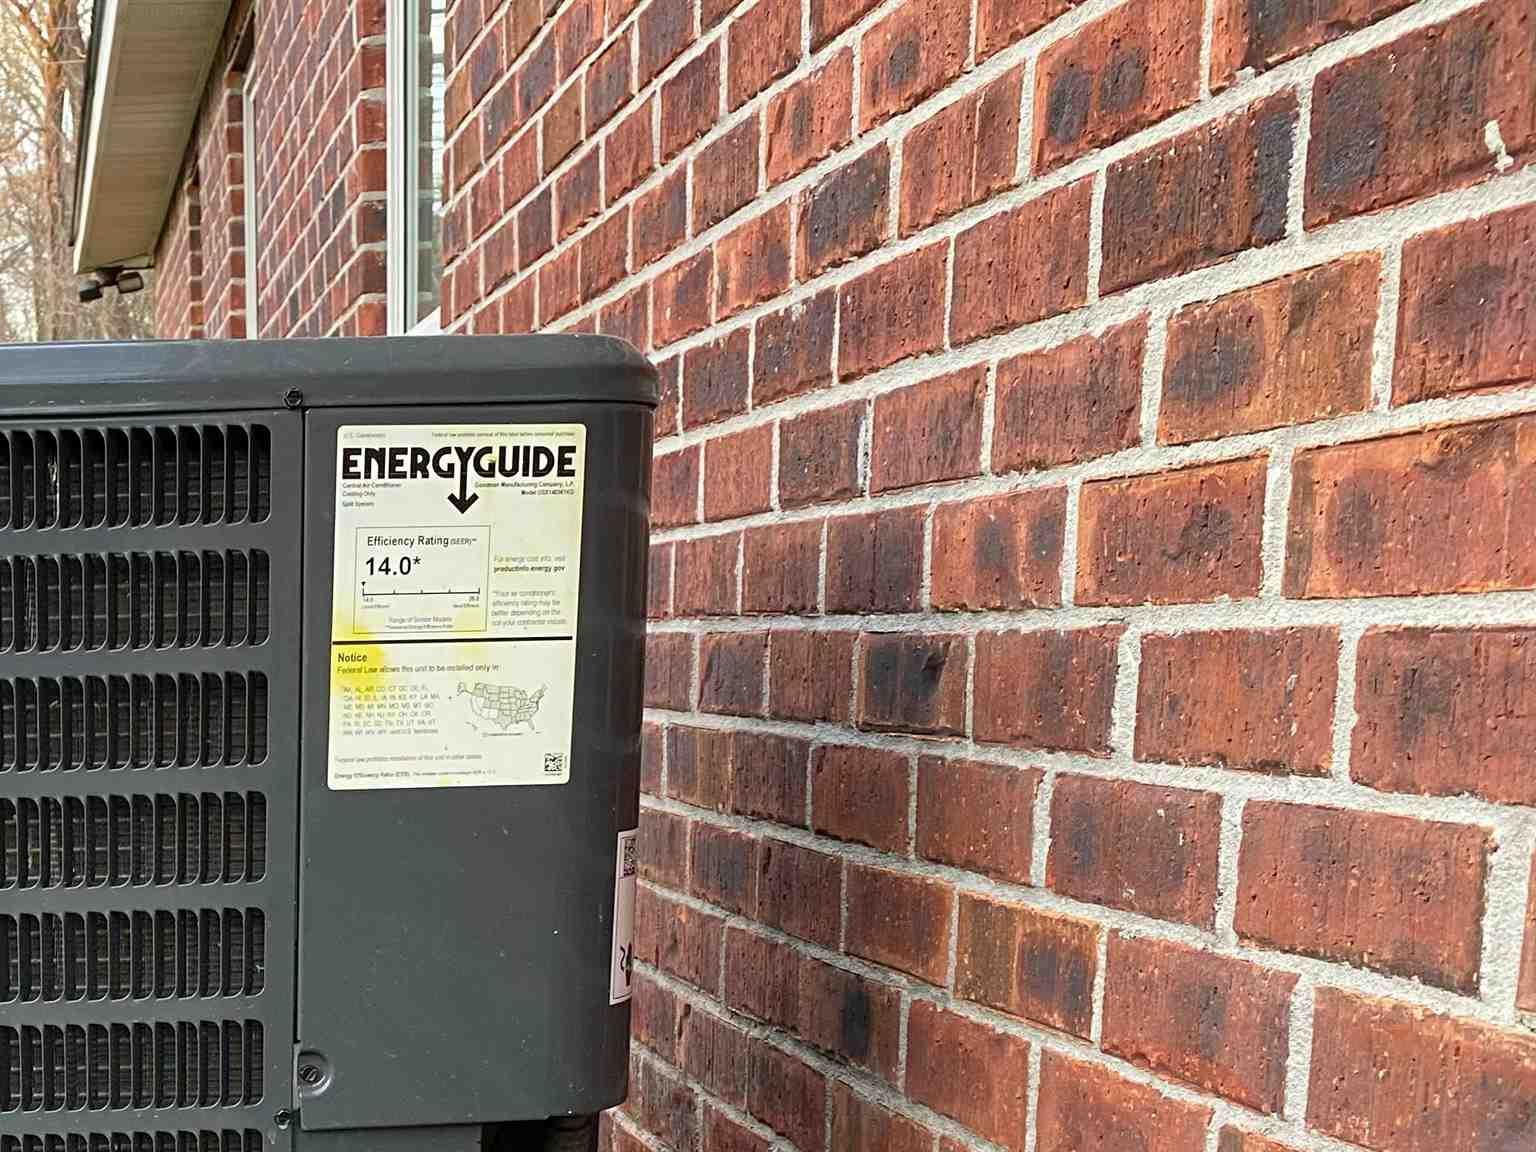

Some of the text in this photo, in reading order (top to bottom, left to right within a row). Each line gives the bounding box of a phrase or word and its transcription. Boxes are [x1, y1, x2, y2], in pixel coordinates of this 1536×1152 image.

[342, 445, 577, 480] ENERGYGUIDE
[367, 536, 415, 548] Efficiency
[418, 535, 449, 548] Rating
[337, 653, 368, 663] Notice
